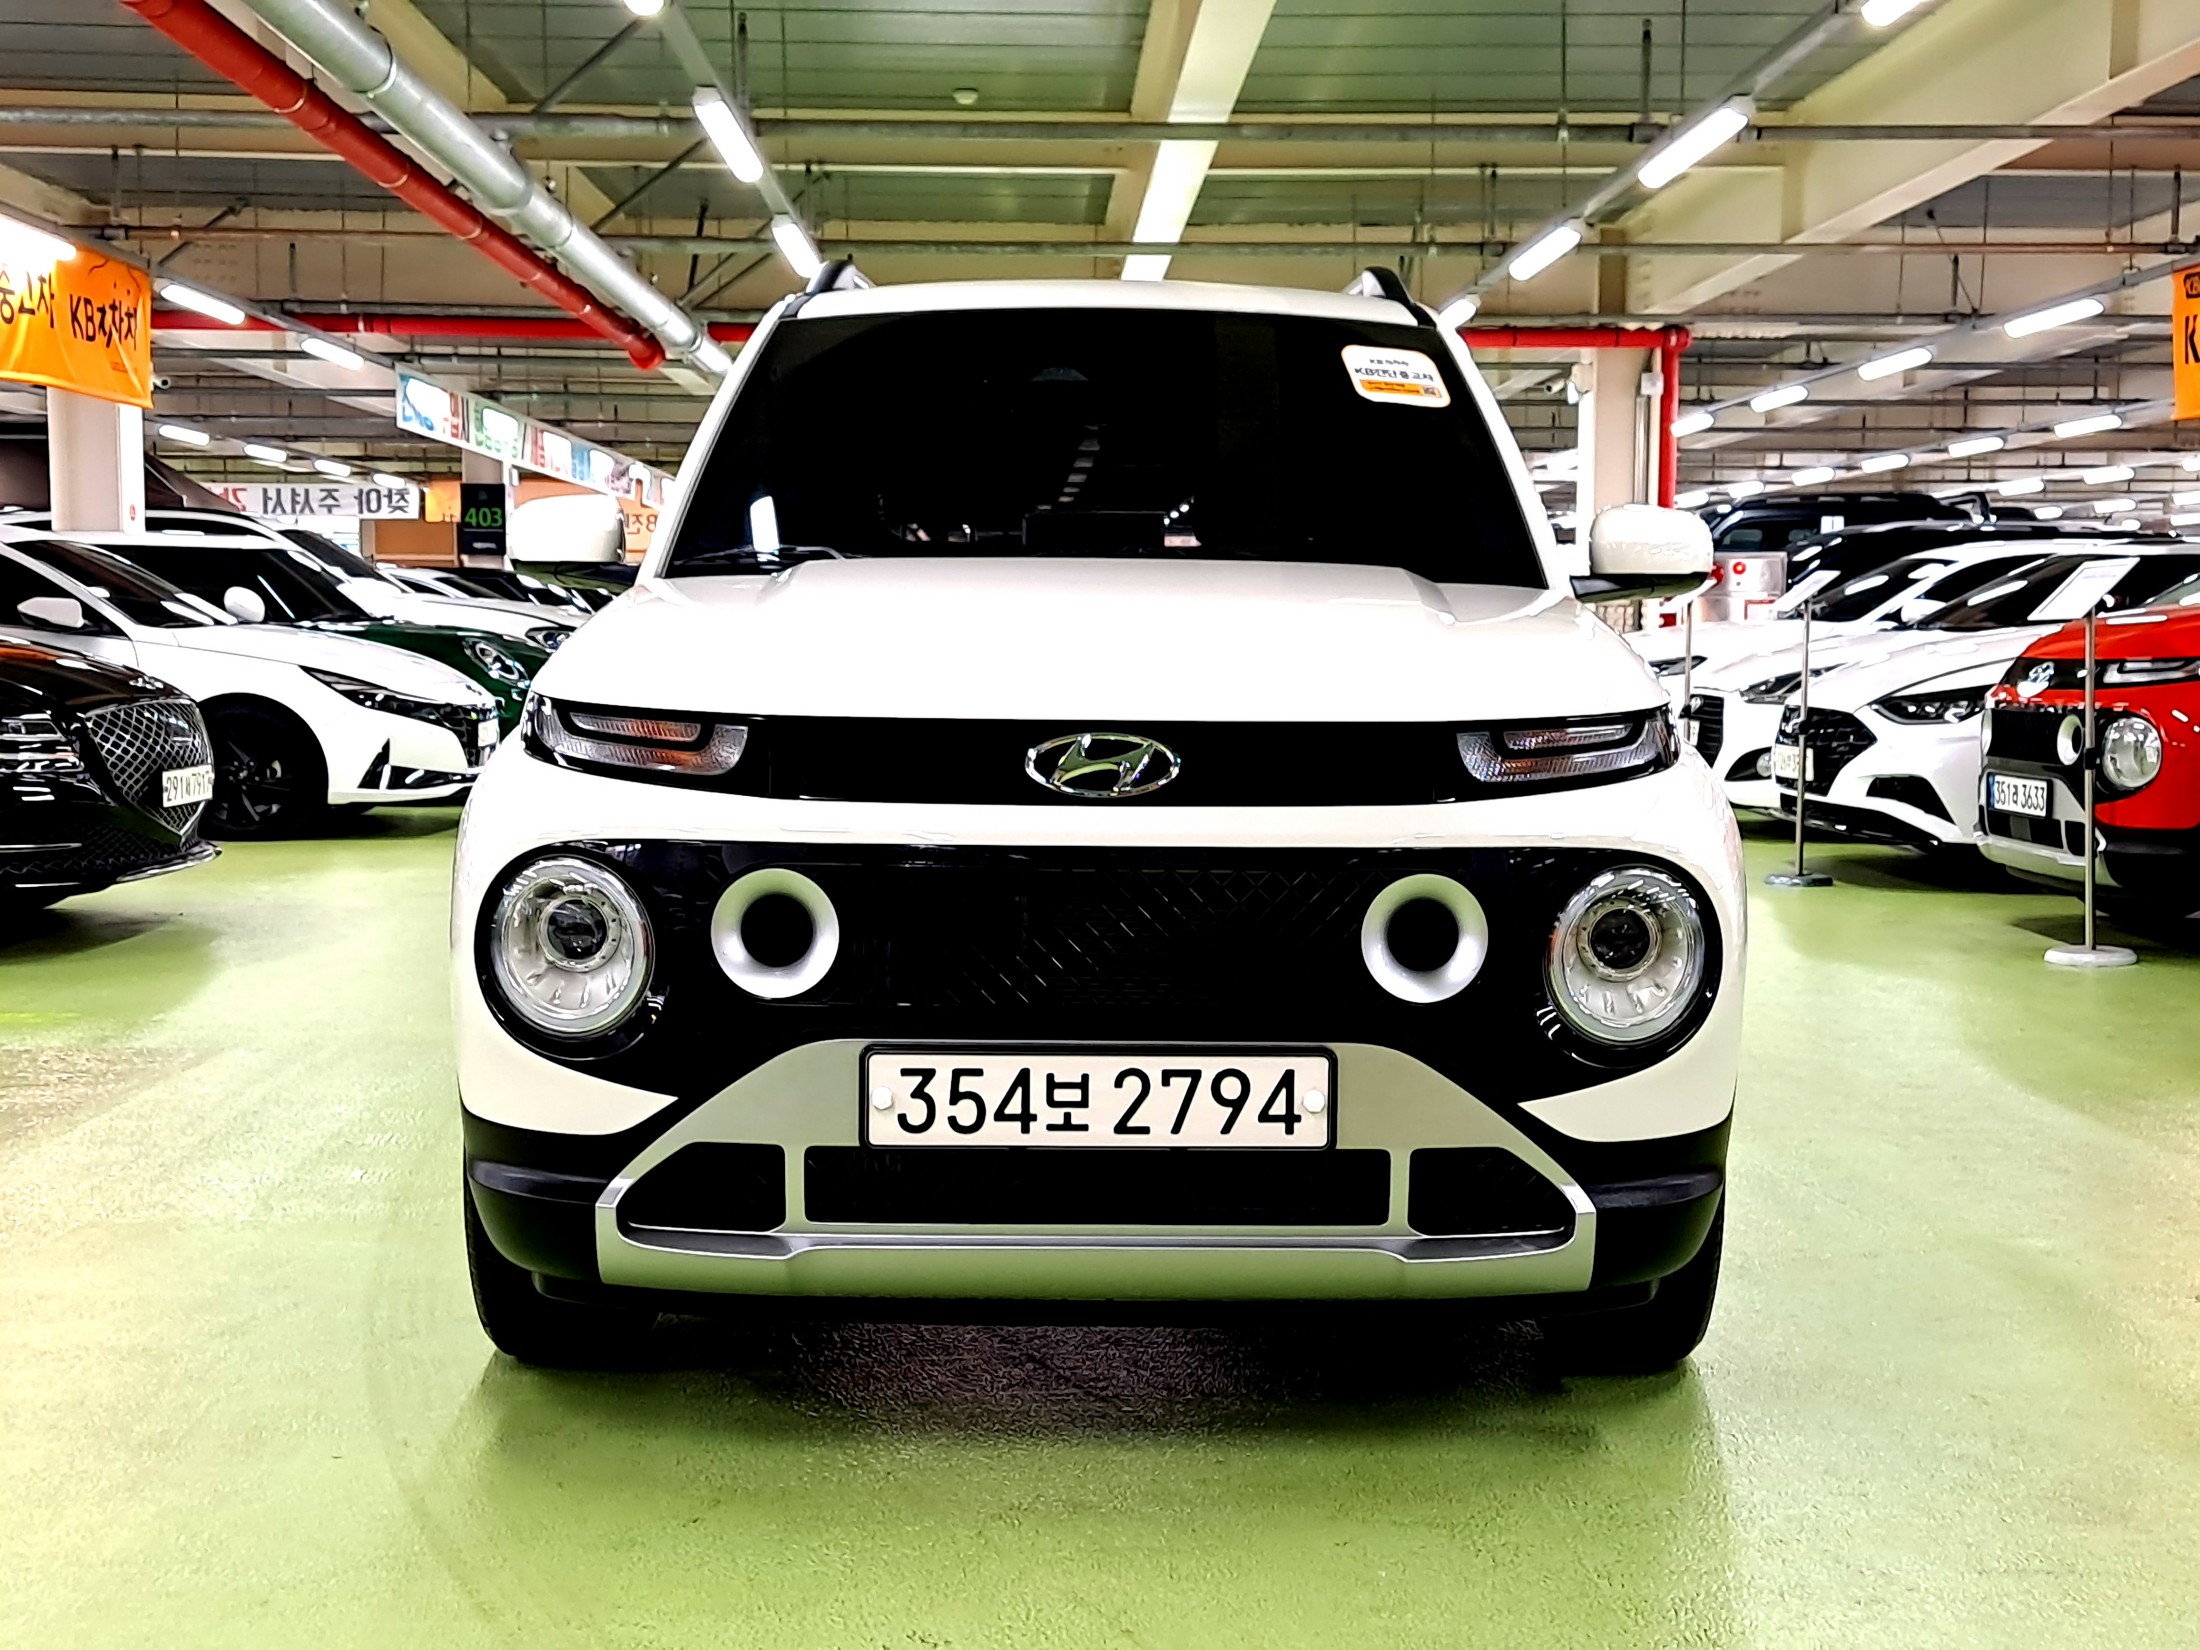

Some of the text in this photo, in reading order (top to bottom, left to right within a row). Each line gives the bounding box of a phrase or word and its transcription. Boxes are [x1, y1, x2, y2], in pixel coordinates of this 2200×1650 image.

[464, 507, 503, 528] 403
[2021, 784, 2045, 812] 3633
[897, 1067, 1303, 1135] 354보 2794
